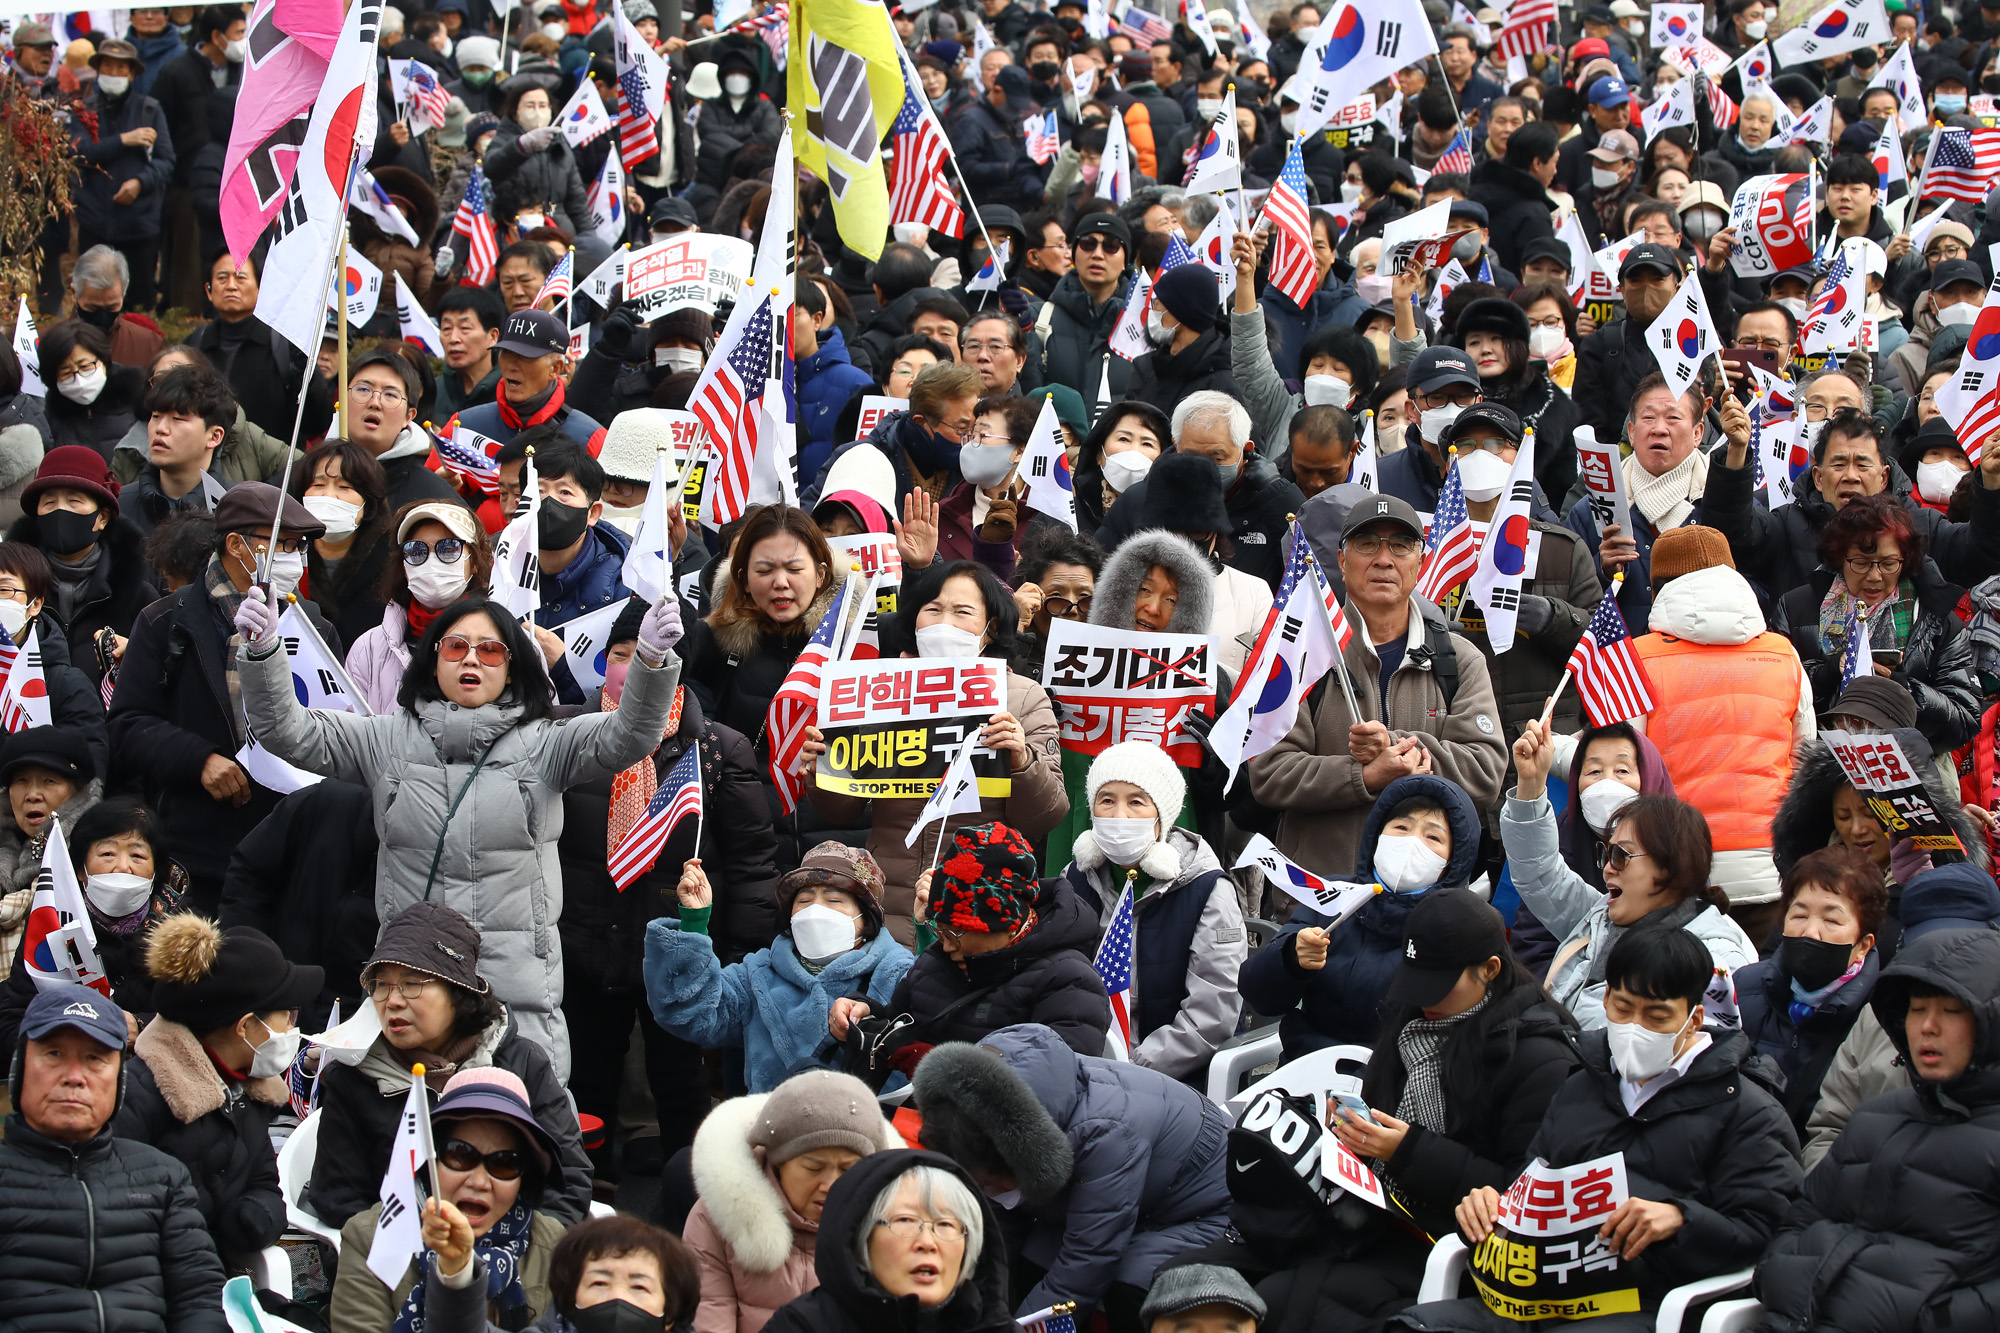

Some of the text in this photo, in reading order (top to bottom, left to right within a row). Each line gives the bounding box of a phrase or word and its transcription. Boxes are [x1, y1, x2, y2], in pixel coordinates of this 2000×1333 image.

[1759, 182, 1796, 248] OUT
[631, 244, 684, 280] 윤석열
[1743, 235, 1769, 271] CCP
[630, 261, 704, 296] 대통령과
[507, 318, 538, 338] THX
[1050, 643, 1209, 690] 조기대선
[829, 664, 999, 722] 탄핵무효
[829, 727, 927, 772] 이재명
[848, 782, 890, 795] STOP
[892, 782, 924, 794] THE
[1892, 794, 1942, 826] 구속
[1406, 938, 1417, 959] LA
[1481, 1287, 1600, 1317] STOP THE STEAL
